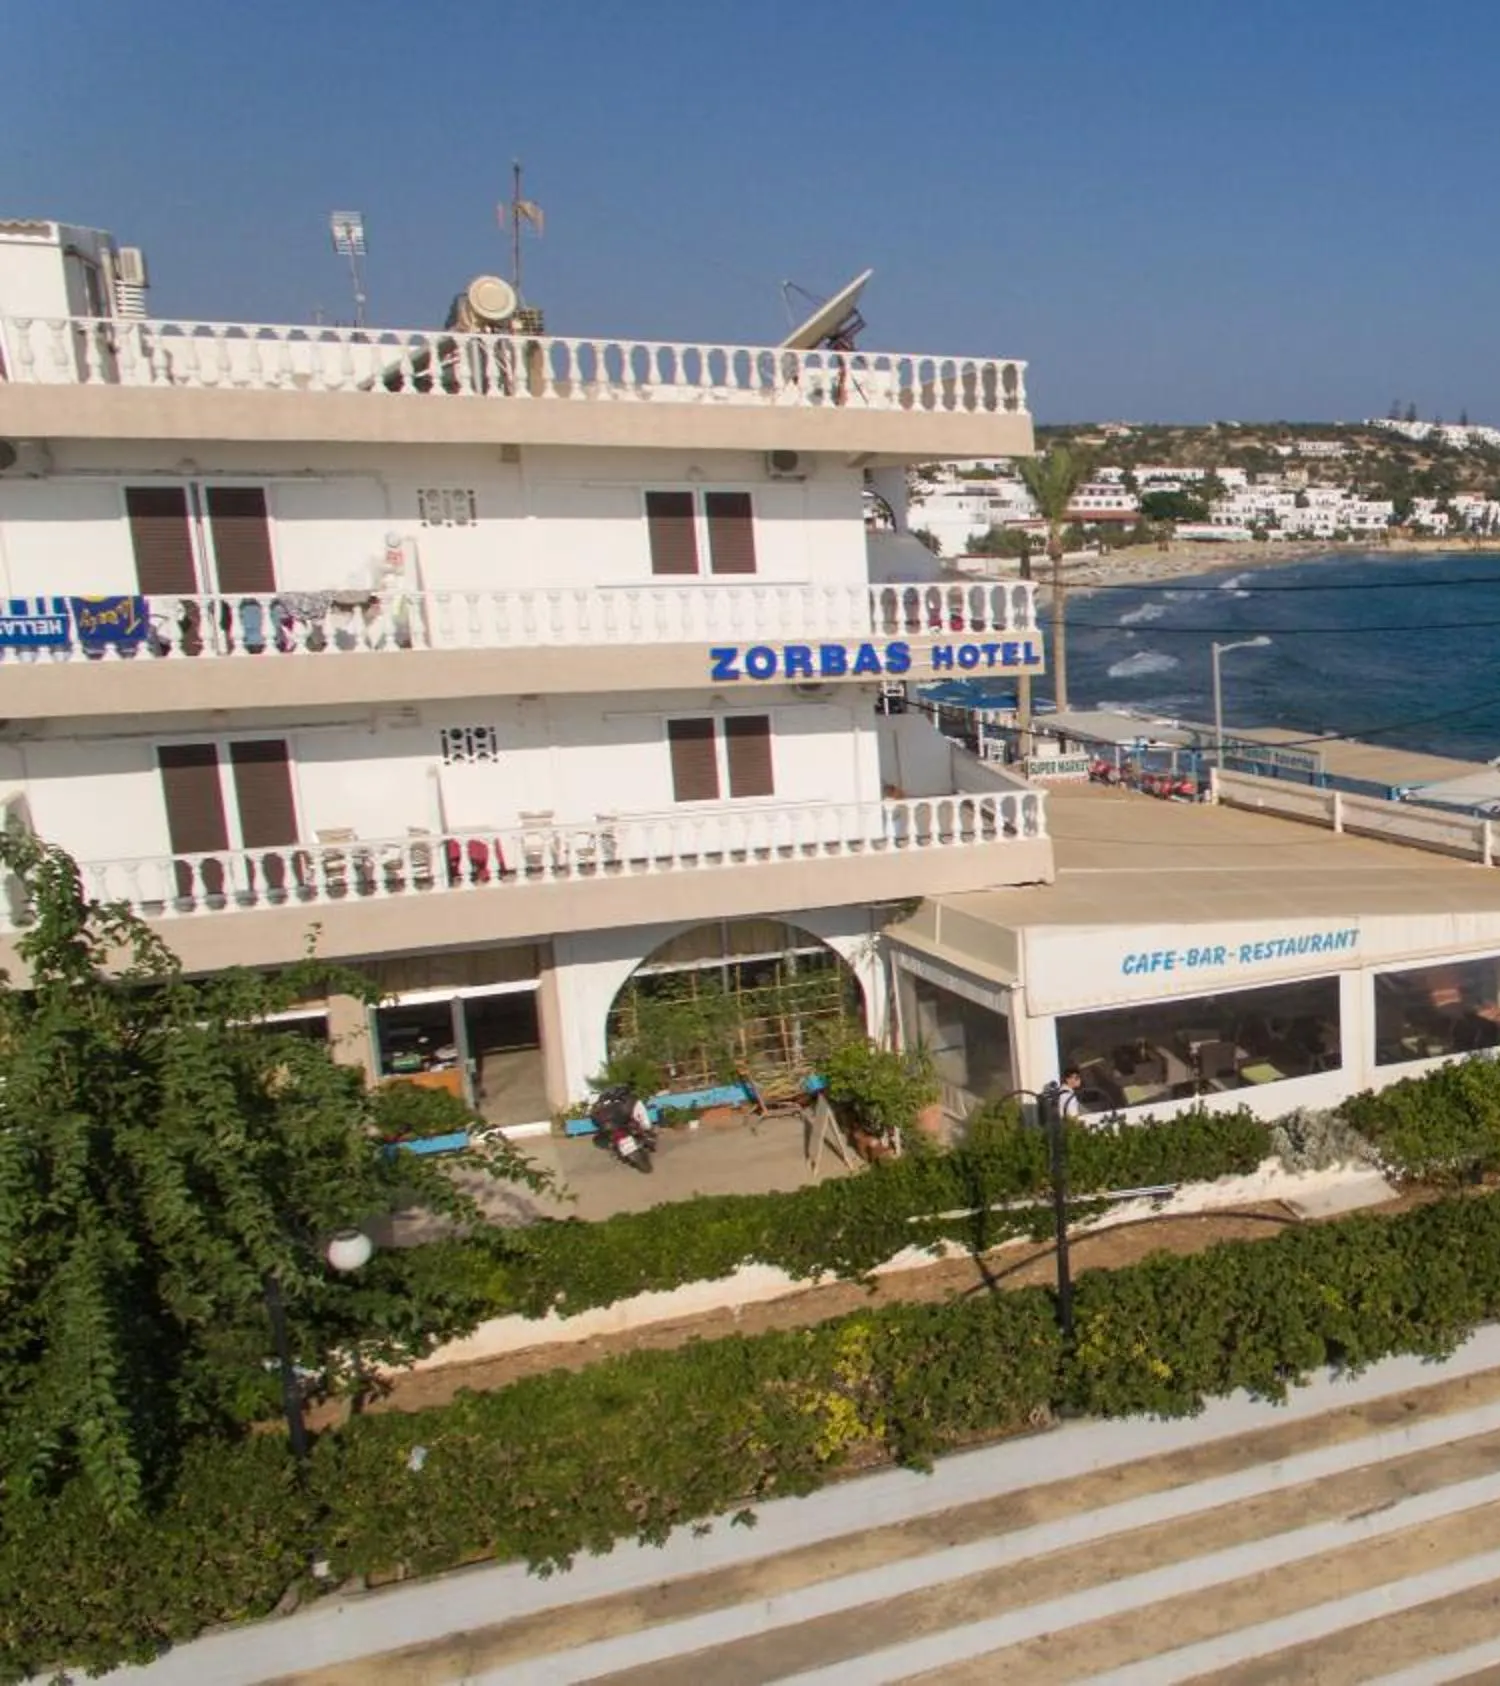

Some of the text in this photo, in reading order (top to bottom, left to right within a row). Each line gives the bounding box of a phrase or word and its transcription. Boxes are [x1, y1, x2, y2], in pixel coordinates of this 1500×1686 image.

[709, 641, 1041, 681] ZORBAS HOTEL
[1030, 761, 1057, 775] SUPER
